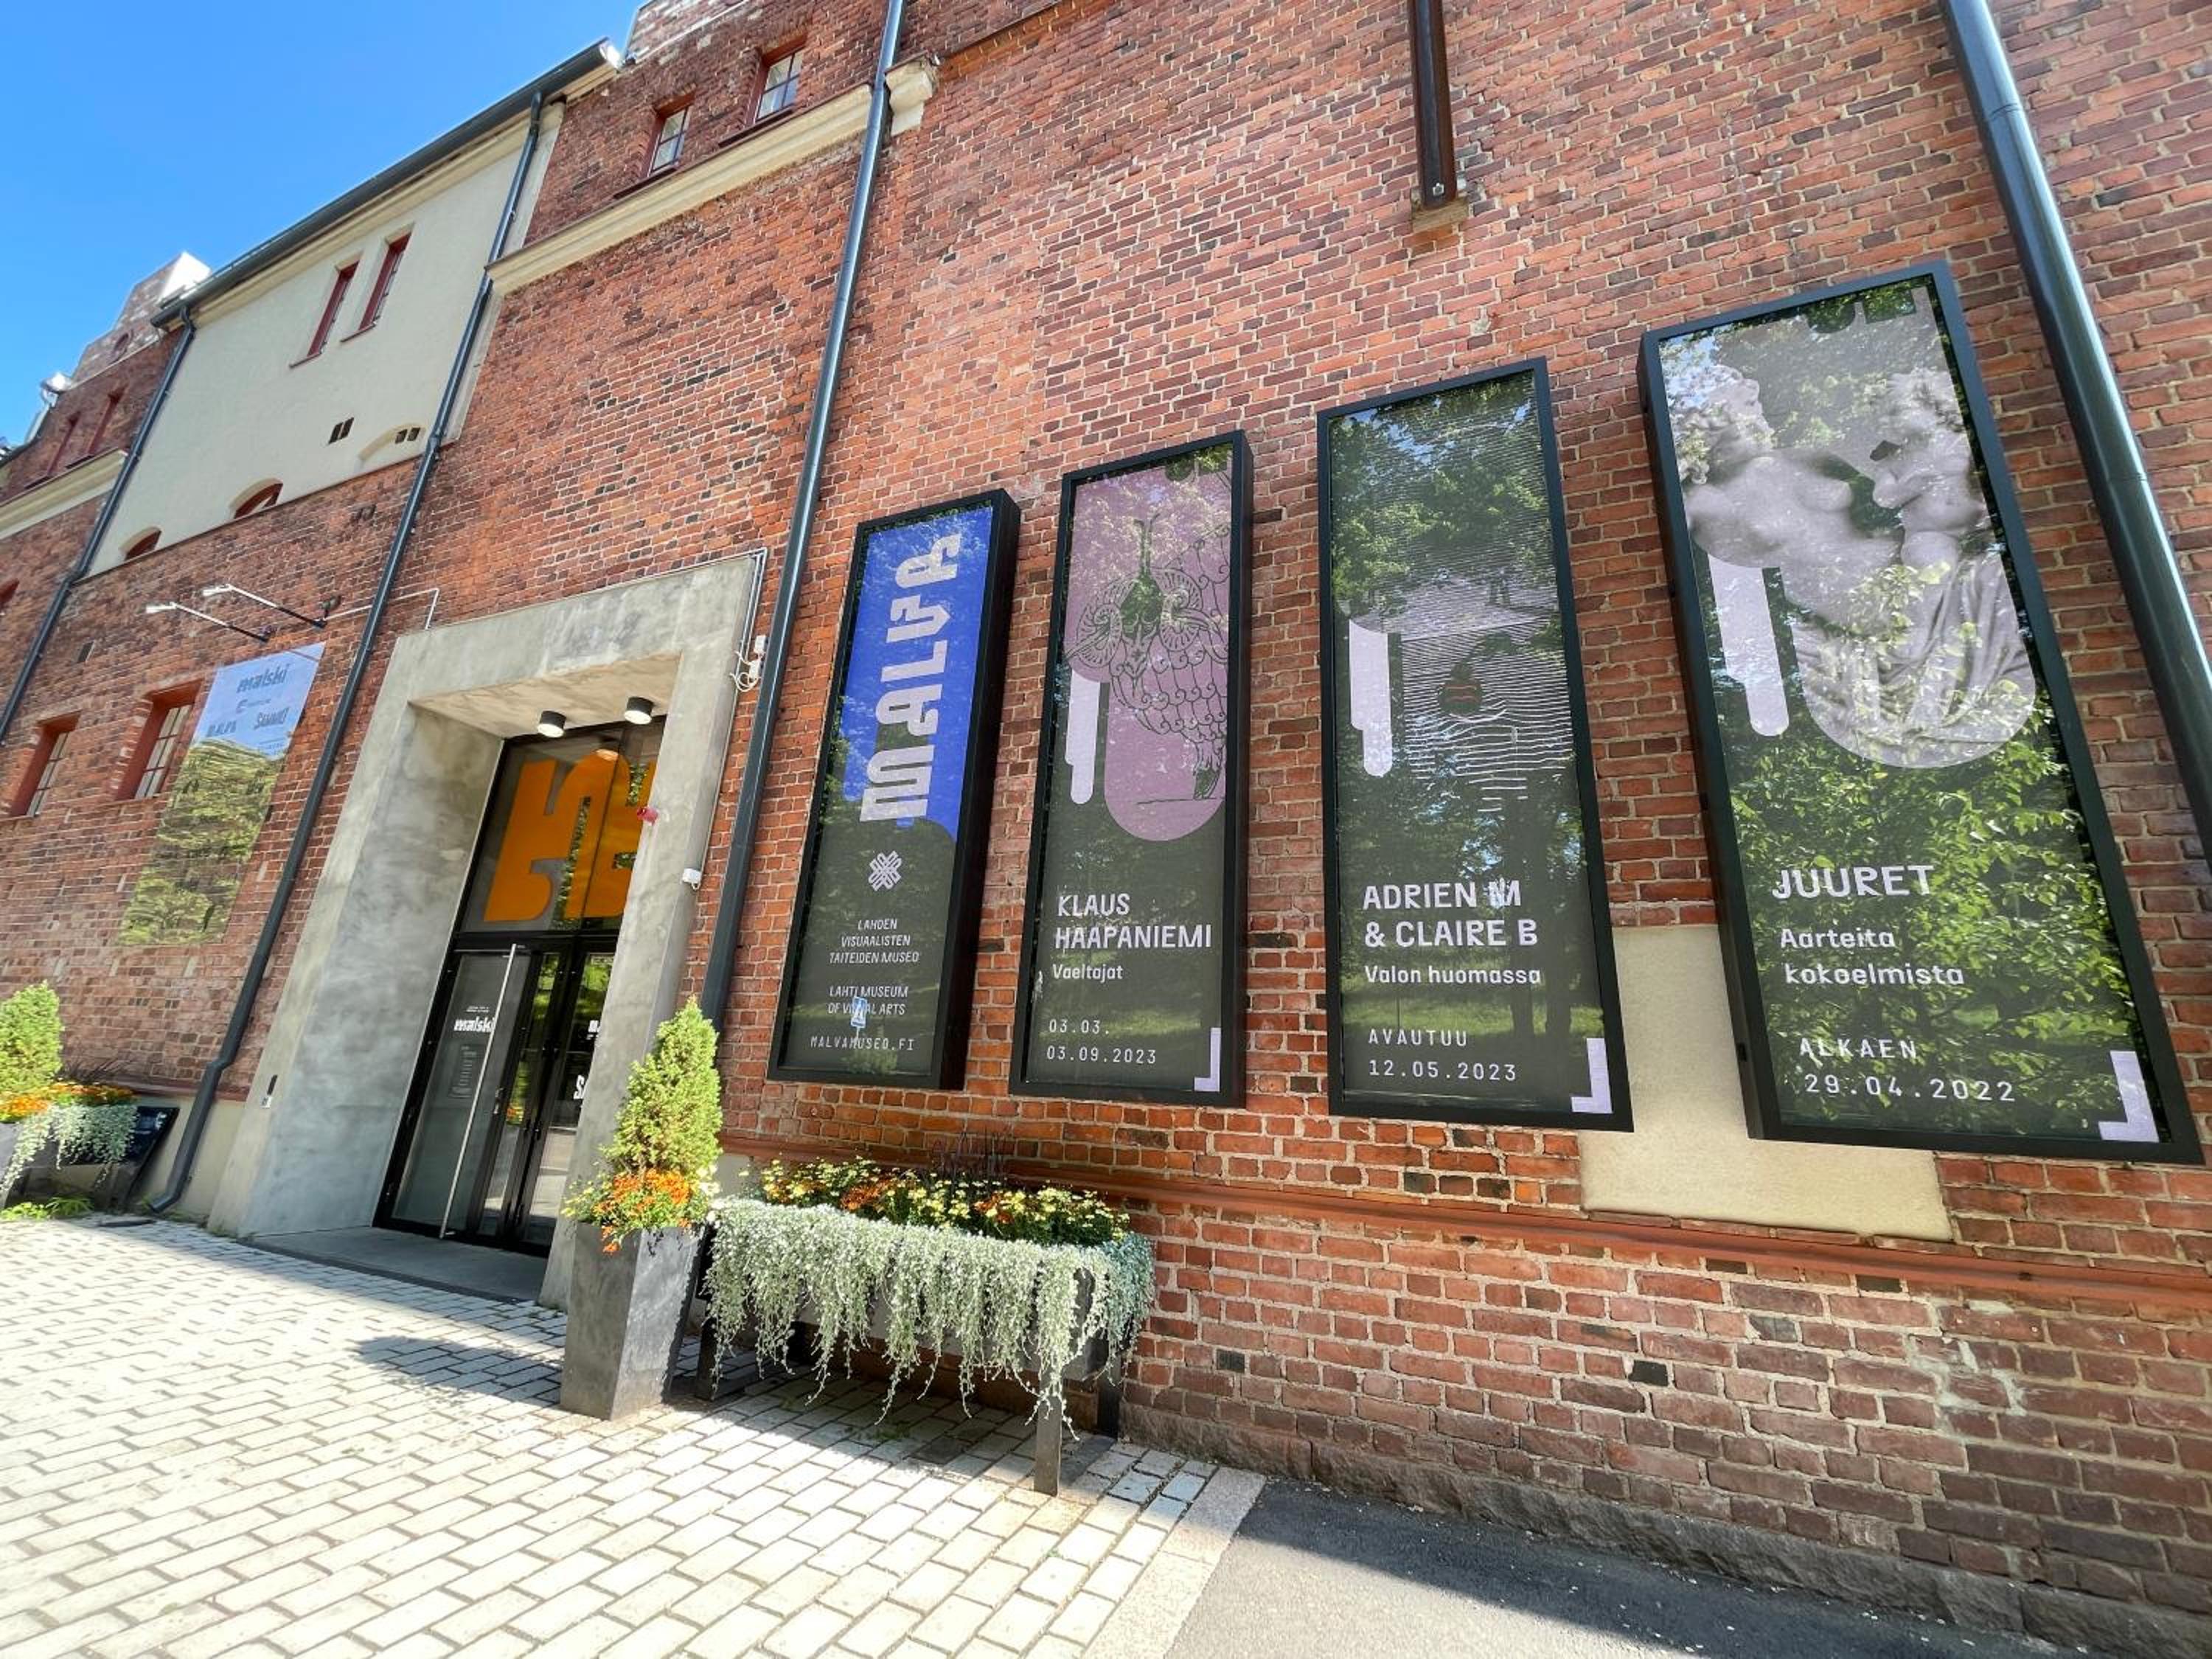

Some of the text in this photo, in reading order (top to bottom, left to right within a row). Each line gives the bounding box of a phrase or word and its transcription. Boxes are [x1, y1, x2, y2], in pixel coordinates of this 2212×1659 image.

[1772, 865, 1935, 899] JUURET
[1363, 880, 1521, 910] ADRIEN M
[1058, 893, 1130, 917] KLAUS
[858, 919, 897, 930] LAHDEN
[1365, 919, 1538, 947] & CLAIRE B
[841, 934, 911, 947] VISUAALISTEN
[1055, 924, 1212, 949] HAAPANIEMI
[1780, 927, 1896, 948] Aarteita
[829, 951, 919, 964] TAITEIDEN MUSEO
[1053, 964, 1124, 983] Vaeltajat
[1365, 965, 1541, 984] Valon huomassa
[1784, 962, 1964, 984] kokoelmista
[830, 986, 909, 998] LAHTI MUSEUM
[827, 1002, 907, 1015] OF VIAL ARTS
[1048, 1019, 1109, 1034] 03.03.
[810, 1036, 915, 1051] MALVAMUSEO.FI
[1368, 1029, 1467, 1046] AVAUTUU
[1046, 1046, 1156, 1064] 03.09.2023
[1799, 1037, 1917, 1059] ALKAEN
[1369, 1060, 1516, 1081] 12.05.2023
[1804, 1074, 2015, 1102] 29.04.2022
